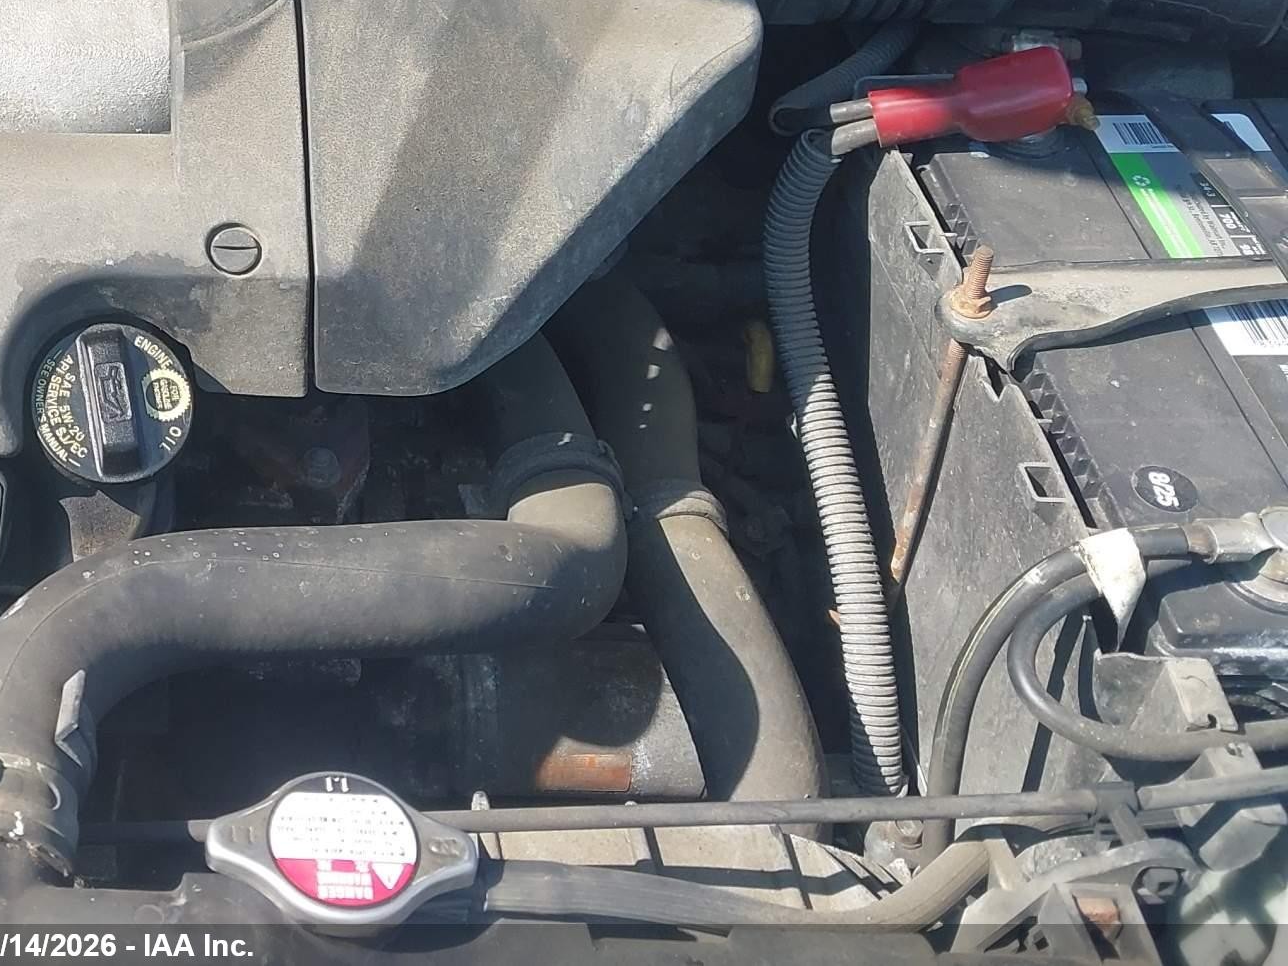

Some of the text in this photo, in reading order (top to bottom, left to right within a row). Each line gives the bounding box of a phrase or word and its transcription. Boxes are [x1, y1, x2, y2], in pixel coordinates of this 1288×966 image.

[1219, 213, 1238, 230] 700
[40, 358, 56, 378] SEE
[55, 354, 74, 375] API
[45, 374, 62, 427] SERVICE
[58, 372, 85, 442] SAE 5W-20
[134, 336, 182, 451] ENGINE OIL
[39, 422, 69, 462] MANUAL
